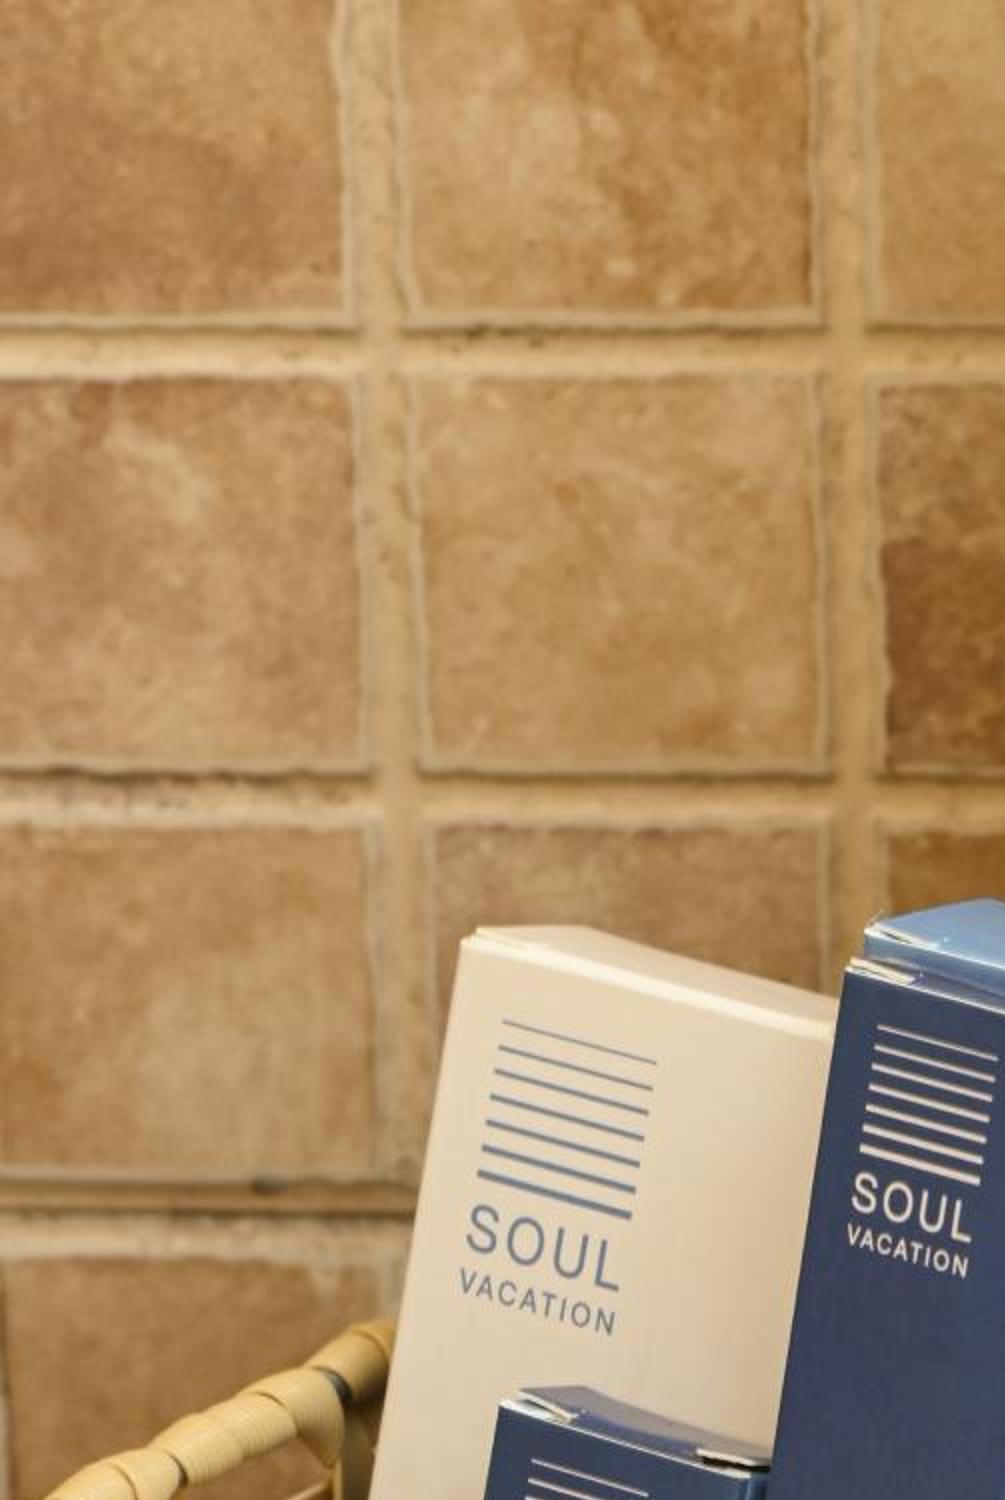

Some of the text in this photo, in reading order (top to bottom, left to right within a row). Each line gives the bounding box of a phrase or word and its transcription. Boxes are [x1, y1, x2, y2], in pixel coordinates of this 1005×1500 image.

[850, 1171, 973, 1244] SOUL
[465, 1203, 621, 1293] SOUL
[847, 1222, 969, 1280] VACATION
[459, 1266, 616, 1337] VACATION
